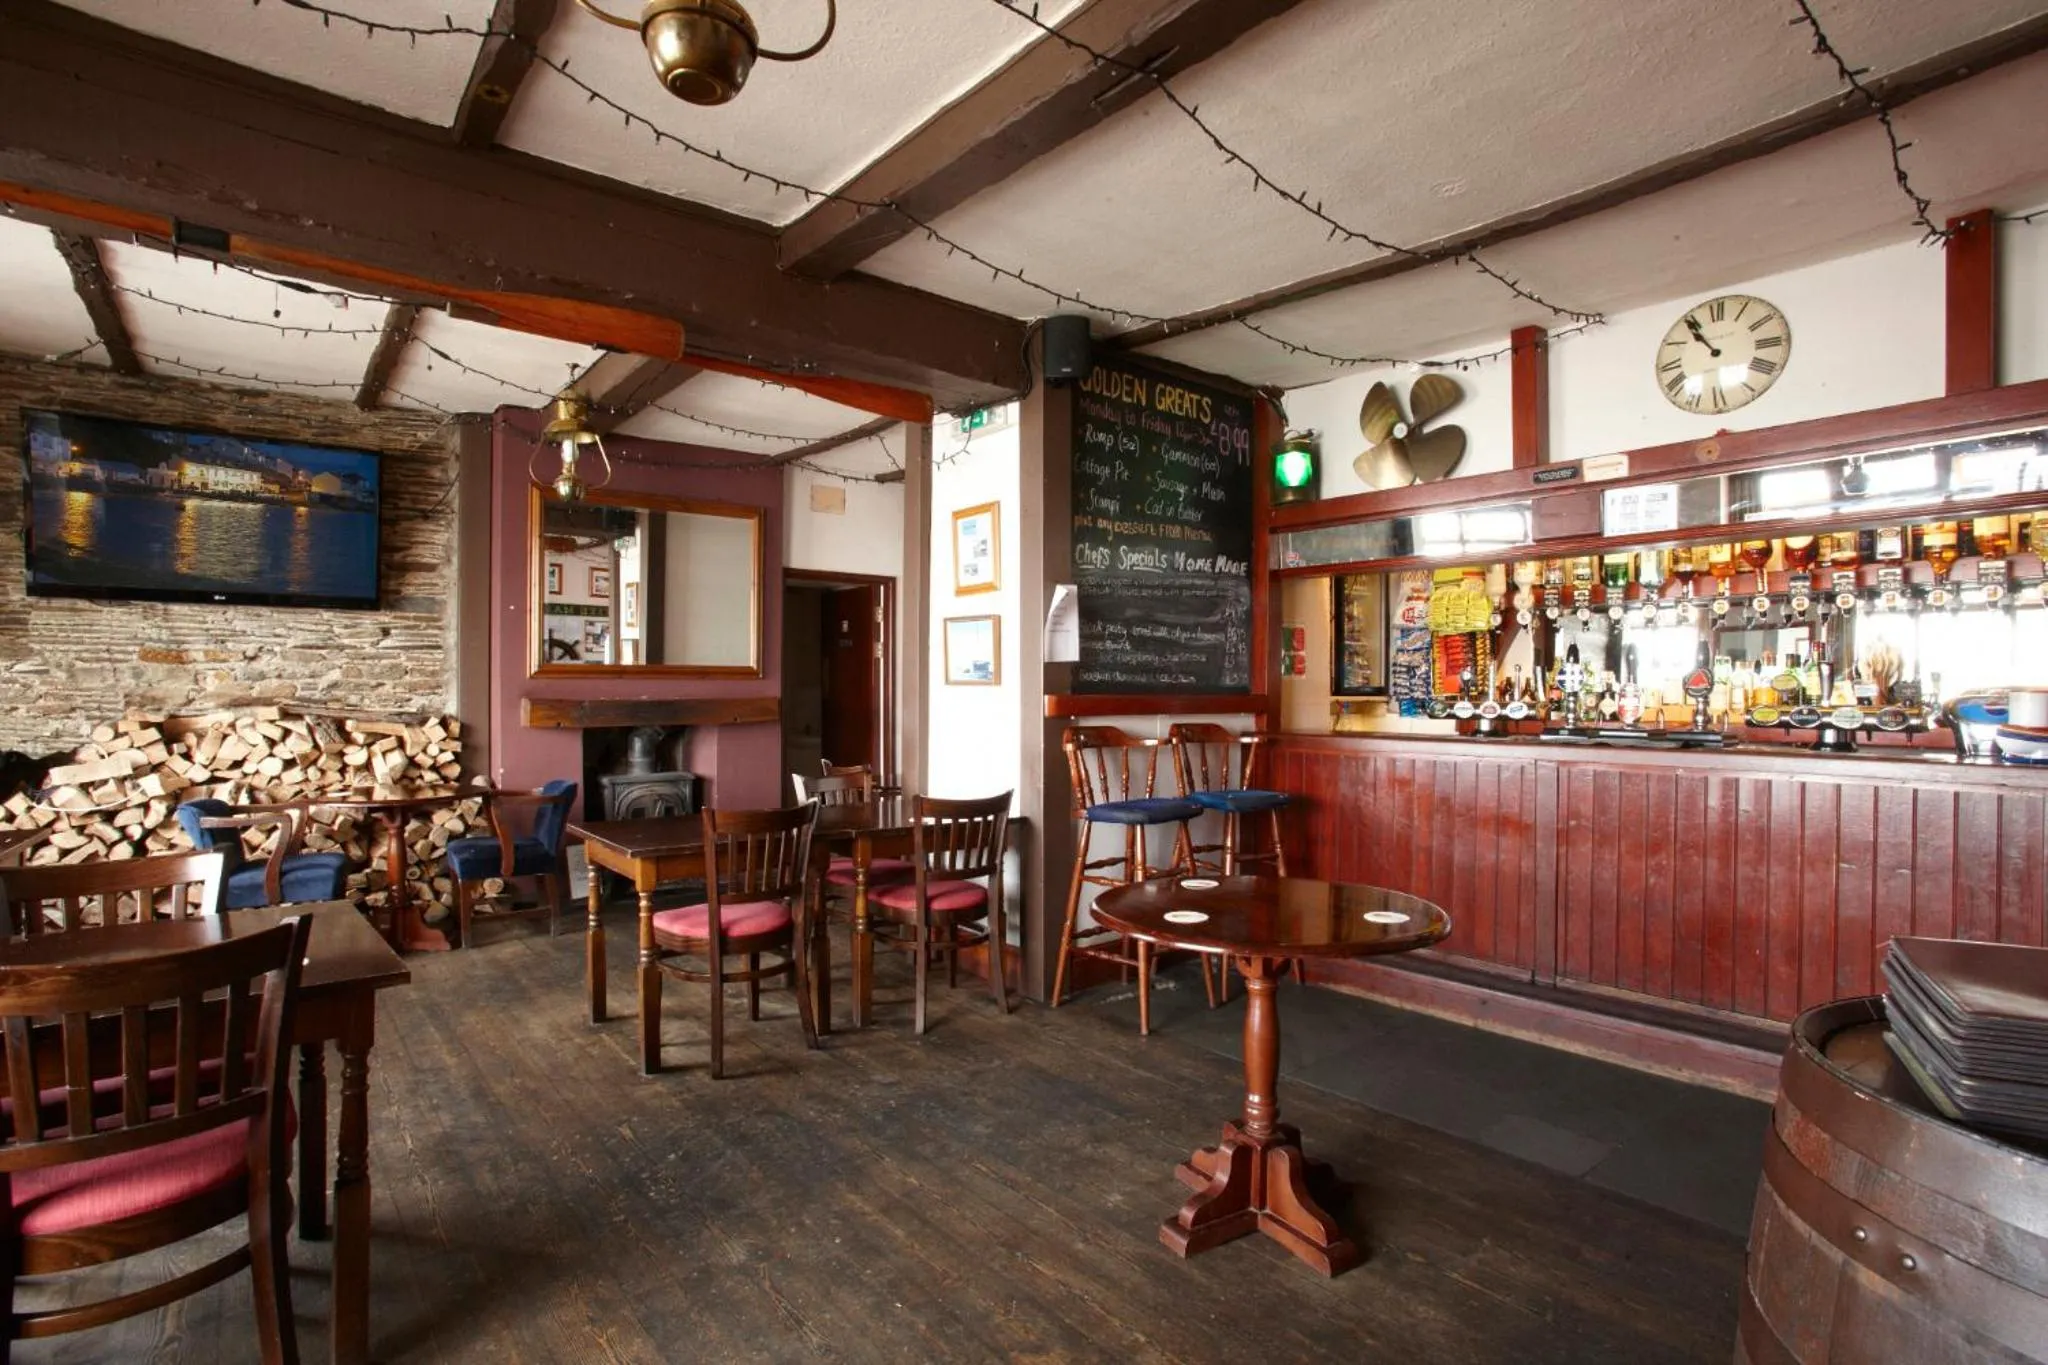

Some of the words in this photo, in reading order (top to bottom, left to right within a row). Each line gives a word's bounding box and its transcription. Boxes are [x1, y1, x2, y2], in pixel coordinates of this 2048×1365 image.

[1155, 383, 1212, 424] GREATS
[1085, 424, 1114, 452] Rump
[1117, 546, 1169, 571] Specials
